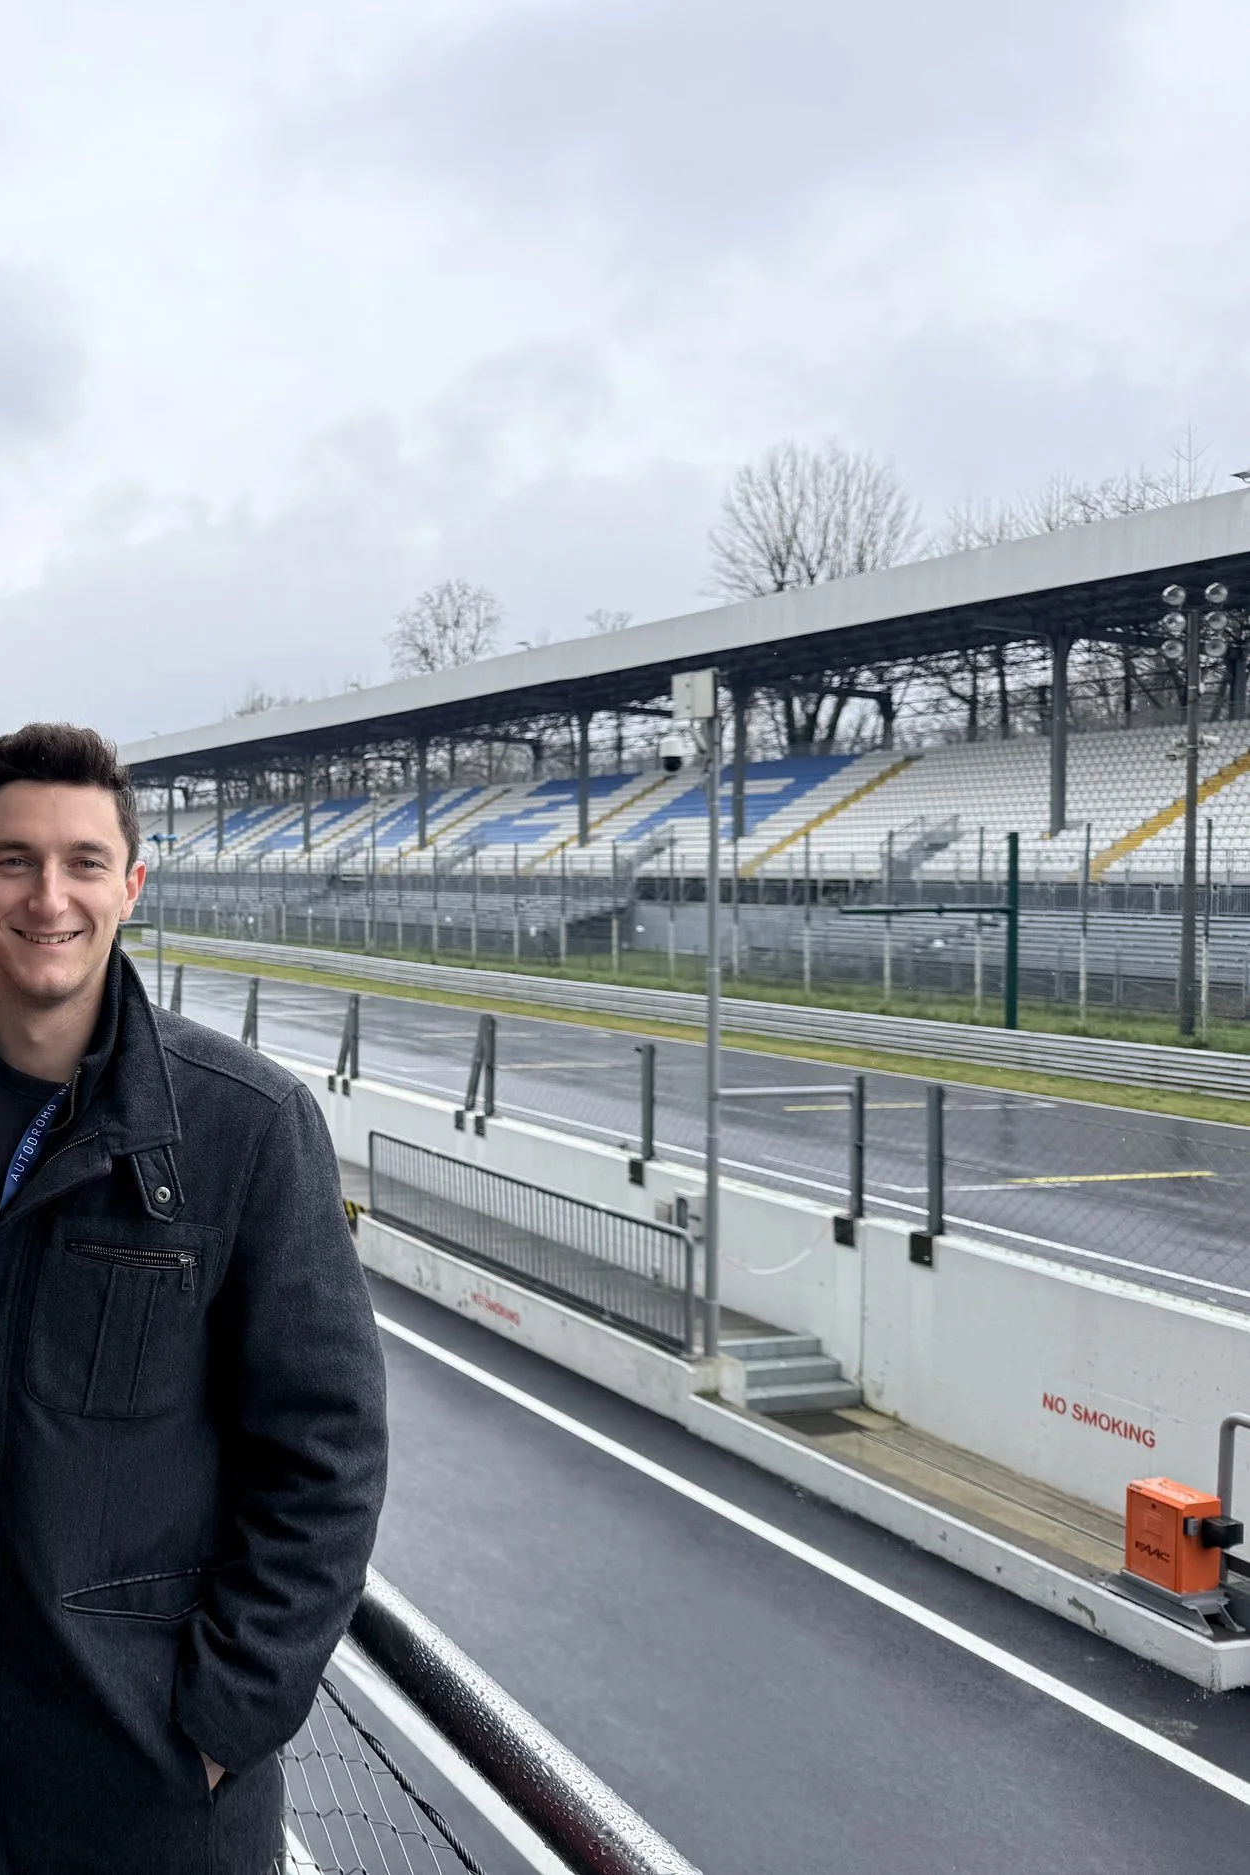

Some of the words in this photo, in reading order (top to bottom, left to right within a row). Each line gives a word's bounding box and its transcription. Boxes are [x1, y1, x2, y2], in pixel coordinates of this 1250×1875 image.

[11, 1104, 57, 1182] AUTODROMO
[1042, 1392, 1067, 1415] NO
[1071, 1403, 1156, 1449] SMOKING
[1134, 1541, 1171, 1564] FAAC
